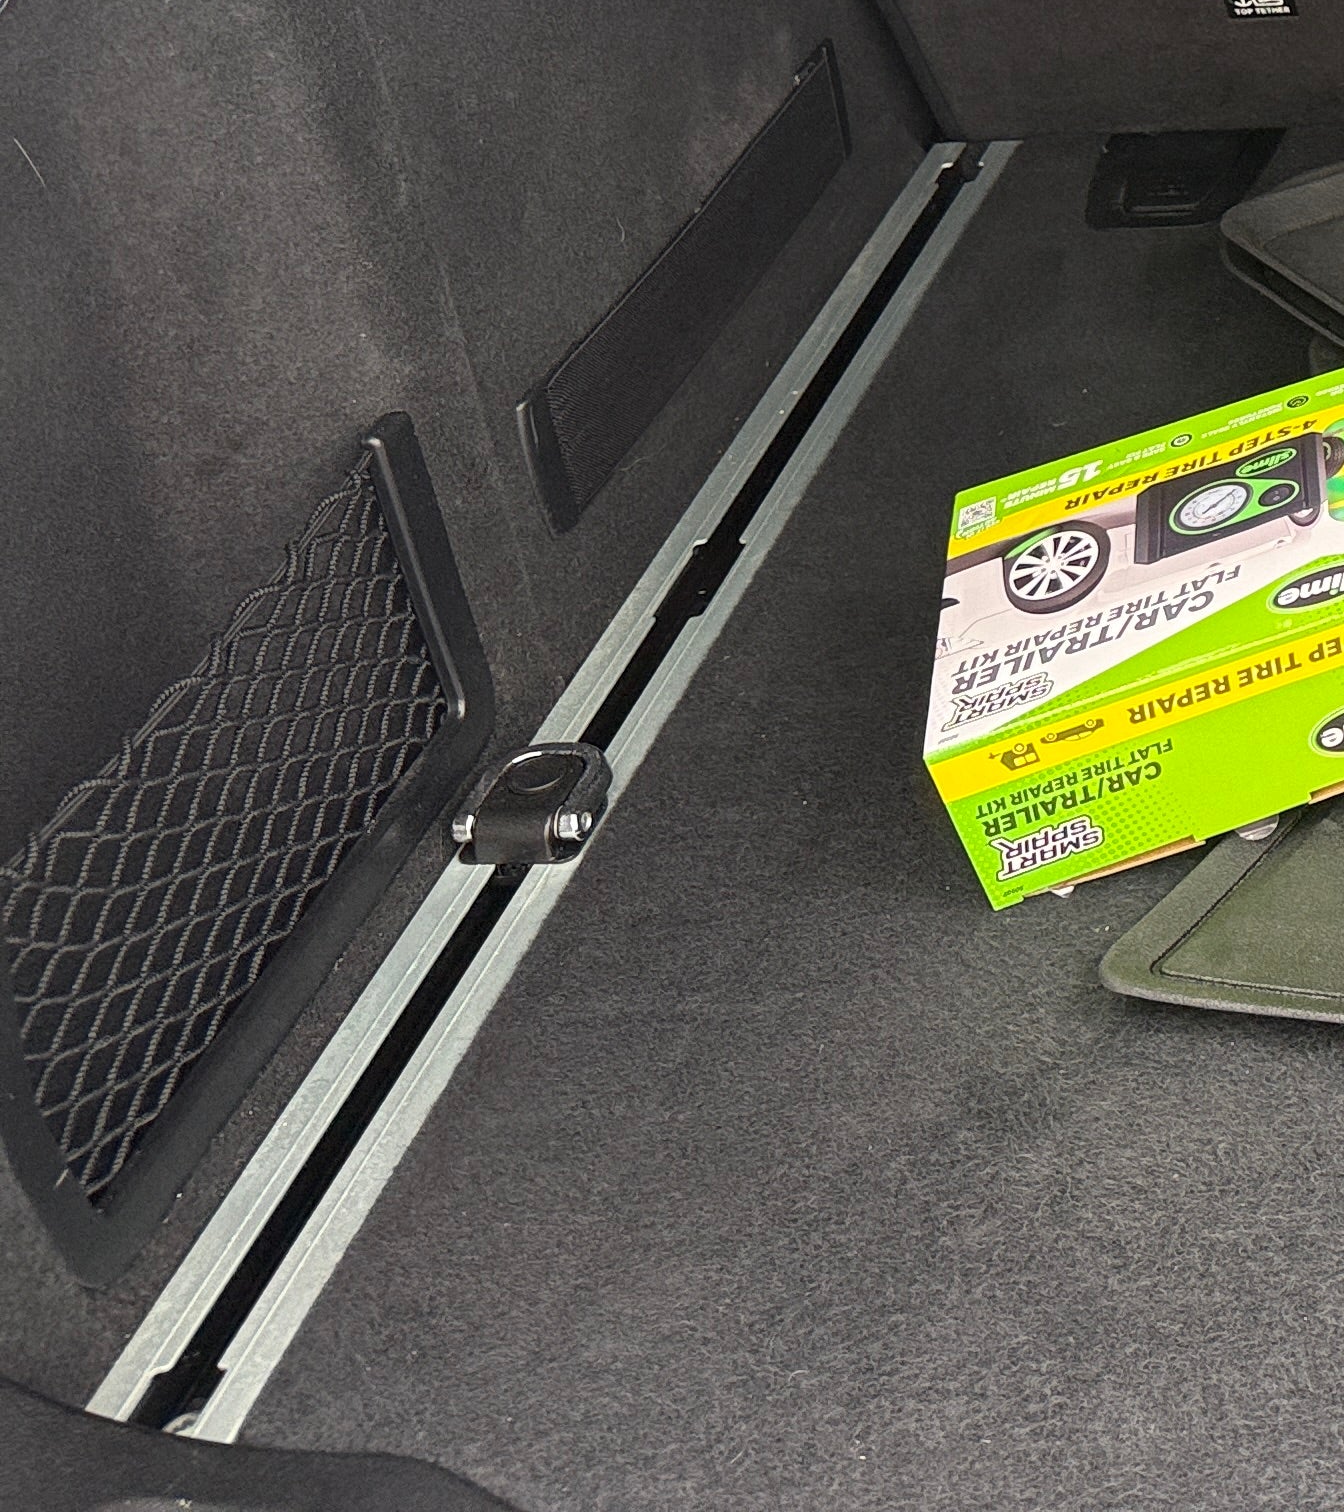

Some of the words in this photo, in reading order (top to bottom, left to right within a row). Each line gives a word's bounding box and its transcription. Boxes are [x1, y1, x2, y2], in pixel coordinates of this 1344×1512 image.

[1234, 8, 1254, 16] TOP
[1255, 5, 1291, 15] TETHER
[1228, 419, 1317, 455] 4-STEP
[1055, 459, 1103, 491] 15
[1165, 454, 1224, 478] TIRE
[1243, 451, 1291, 473] slime
[1065, 471, 1159, 510] REPAIR
[1174, 565, 1241, 598] FLAT
[1108, 591, 1168, 615] TIRE
[951, 590, 1215, 695] CAR/TRAILER
[1005, 612, 1103, 656] REPAIR
[951, 649, 999, 677] KIT
[1238, 653, 1303, 688] TIRE
[948, 683, 1049, 726] SMART
[1126, 675, 1231, 724] REPAIR
[1081, 757, 1126, 781] TIRE
[1128, 738, 1174, 766] FLAT
[982, 761, 1162, 837] CAR/TRAILER
[1009, 771, 1079, 805] REPAIR
[975, 796, 1007, 820] KIT
[997, 819, 1087, 859] SPAIR
[1002, 830, 1099, 876] SMART
